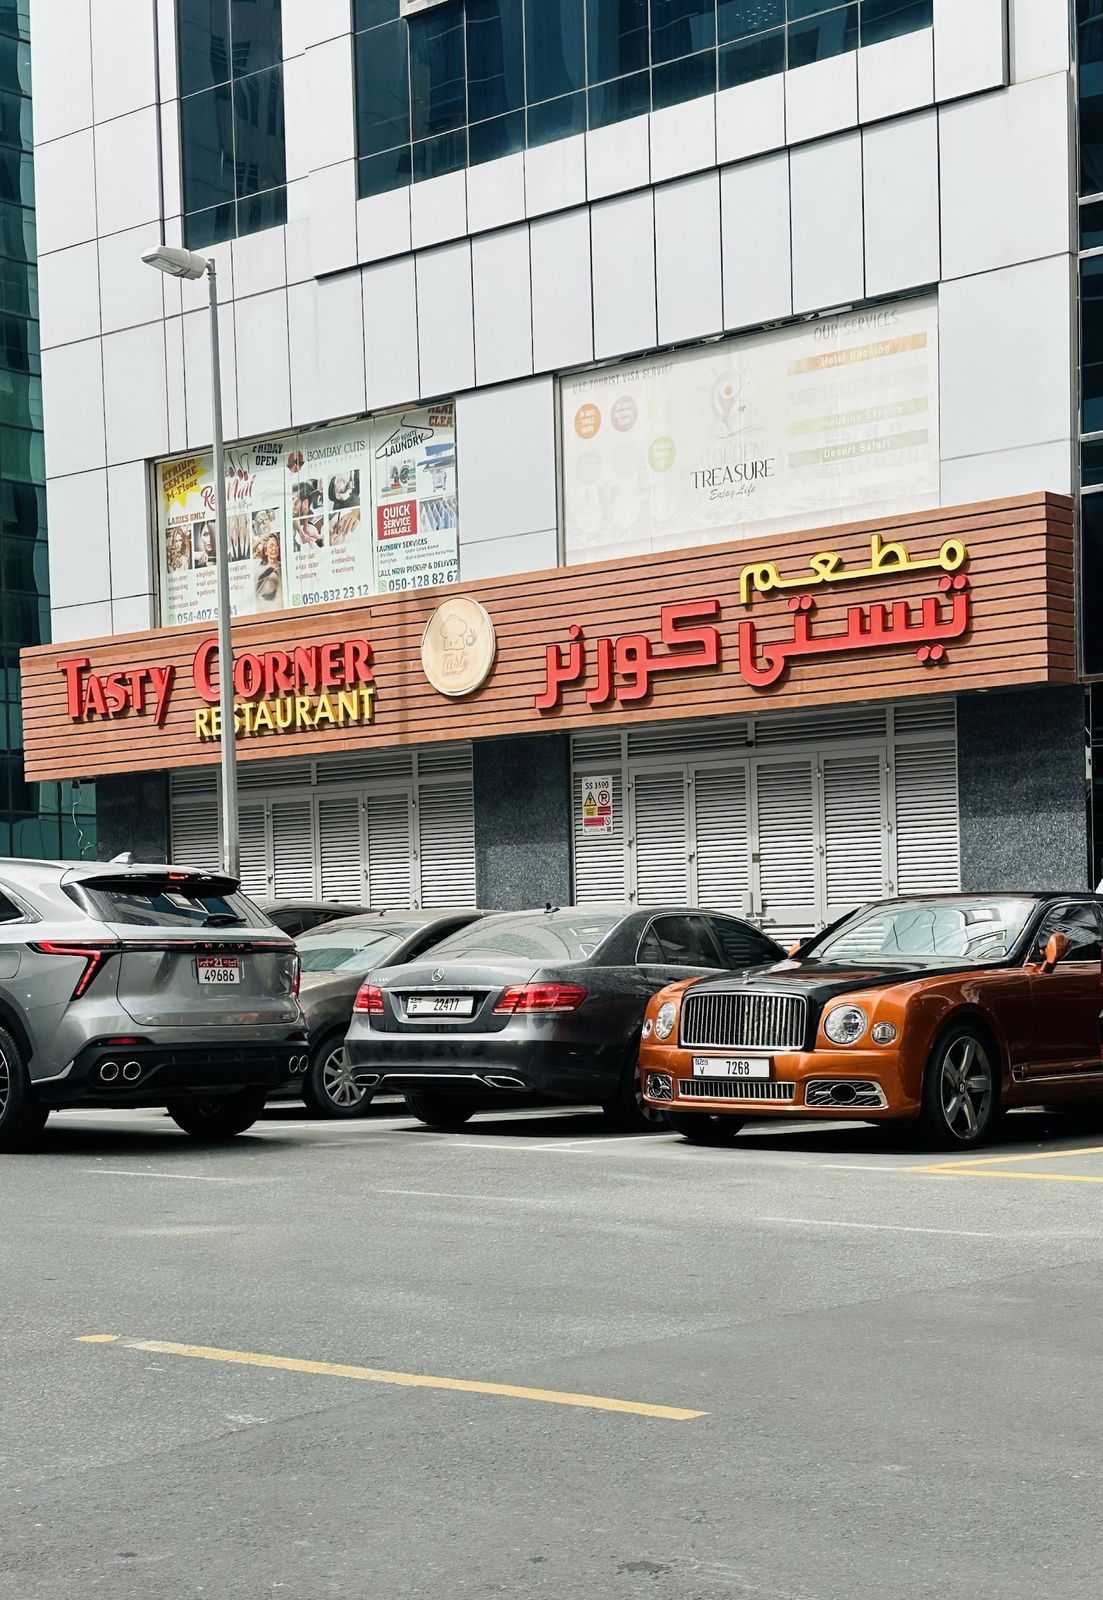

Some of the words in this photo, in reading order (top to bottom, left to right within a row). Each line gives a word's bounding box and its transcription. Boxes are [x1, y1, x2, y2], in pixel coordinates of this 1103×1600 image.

[814, 324, 838, 341] OUR
[844, 310, 898, 335] SERVICES
[591, 374, 621, 390] TOURIST
[623, 371, 640, 383] VISA
[252, 443, 284, 454] FRIDAY
[307, 445, 342, 462] BOMBAY
[343, 440, 366, 454] CUTS
[386, 432, 424, 457] LAUNDRY
[824, 446, 856, 459] Desert
[255, 456, 278, 466] OPEN
[690, 457, 776, 489] TREASURE
[166, 478, 198, 502] M-Floor
[710, 488, 735, 501] Enjoy
[736, 483, 756, 497] Life
[383, 503, 411, 520] QUICK
[383, 516, 411, 530] SERVICE
[402, 537, 428, 549] SERVICES
[391, 566, 406, 575] NOW
[406, 563, 427, 574] PICKUP
[738, 533, 968, 604] مطعم
[388, 574, 430, 592] 050-128
[432, 571, 445, 585] 82
[446, 569, 458, 583] 67
[303, 588, 341, 605] 050-832
[343, 586, 355, 599] 23
[357, 584, 369, 597] 12
[534, 599, 721, 709] كورنر
[213, 957, 224, 967] 21
[204, 969, 235, 982] 49686
[433, 998, 460, 1011] 22477
[725, 1060, 750, 1075] 7268
